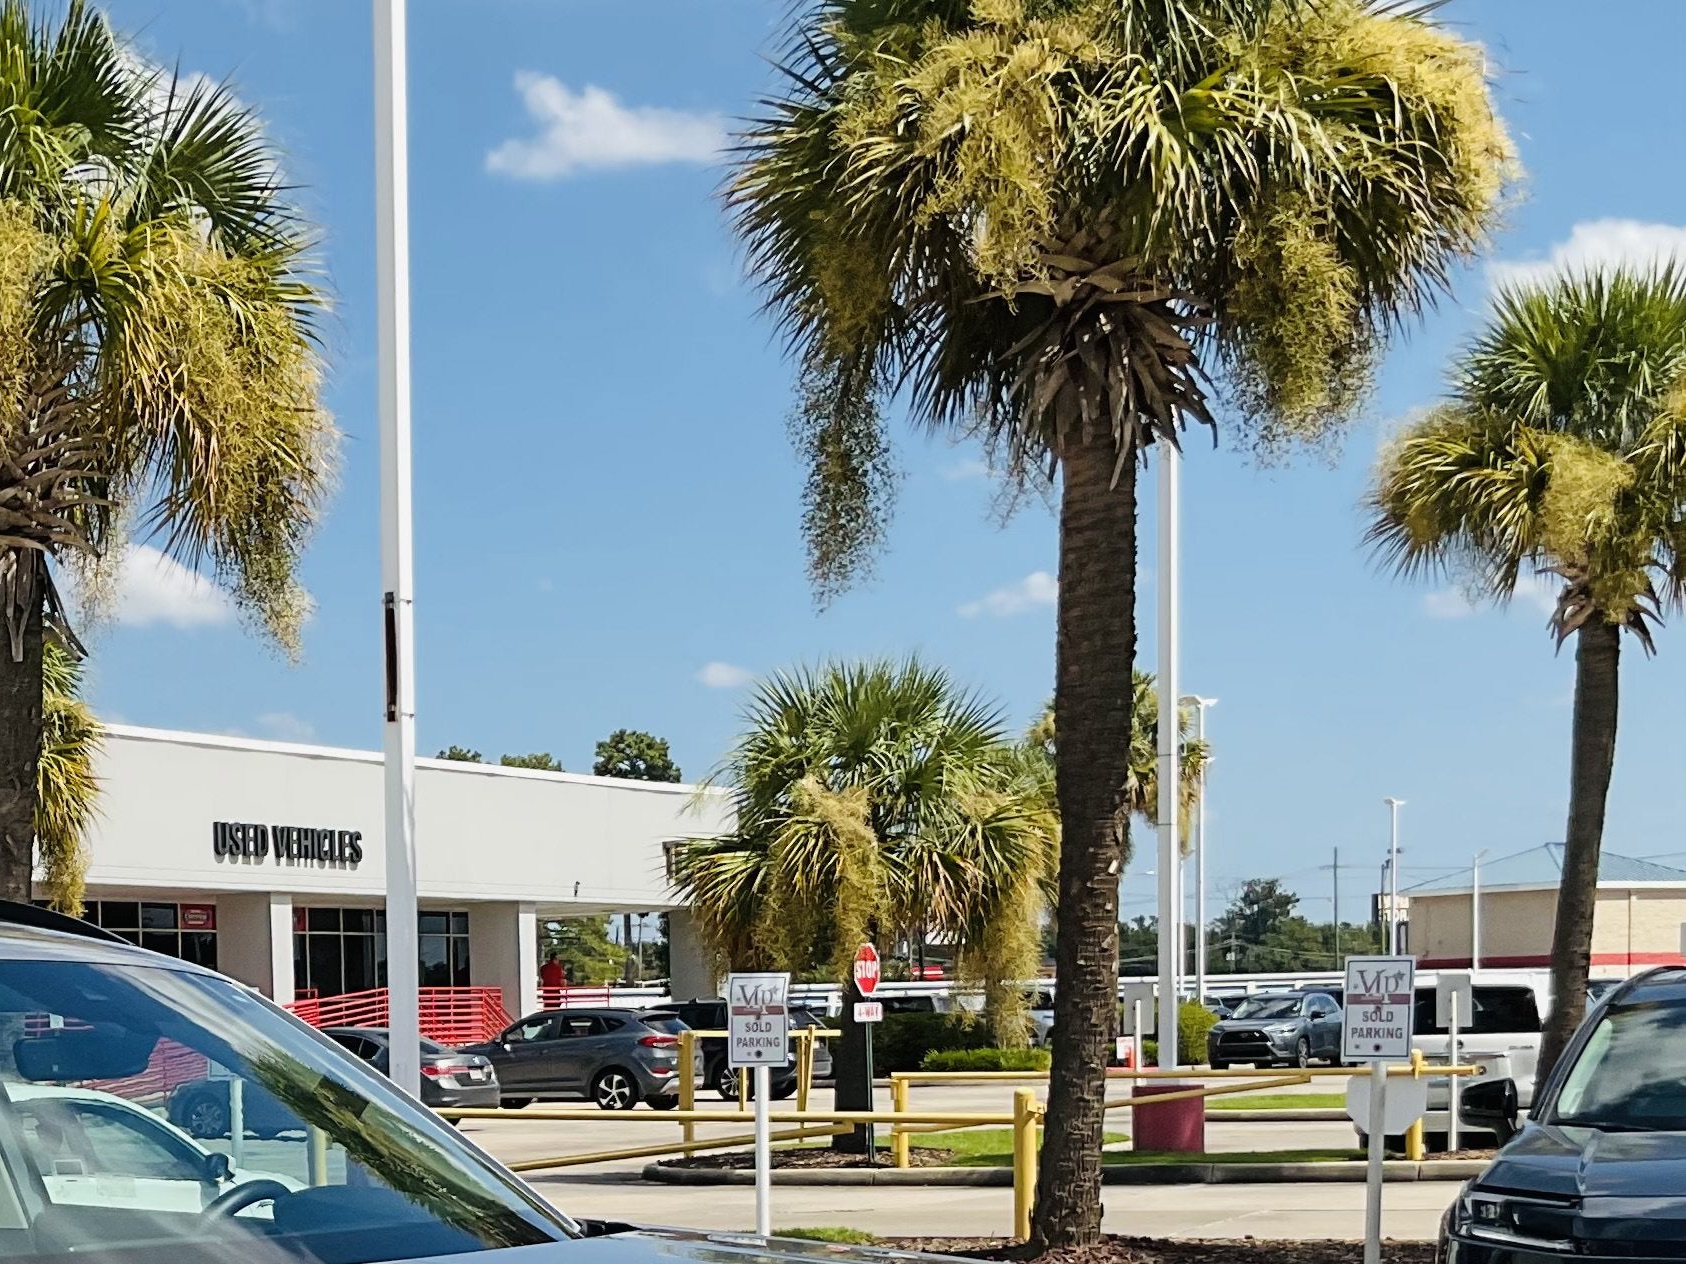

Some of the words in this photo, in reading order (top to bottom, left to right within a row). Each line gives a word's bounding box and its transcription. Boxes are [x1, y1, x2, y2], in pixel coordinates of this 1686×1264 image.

[213, 821, 269, 857] USED
[271, 825, 363, 864] VEHICLES
[855, 959, 877, 979] STOP
[1361, 1011, 1394, 1023] SOLD
[745, 1021, 772, 1033] SOLD
[1350, 1027, 1403, 1039] PARKING
[736, 1036, 781, 1048] PARKING
